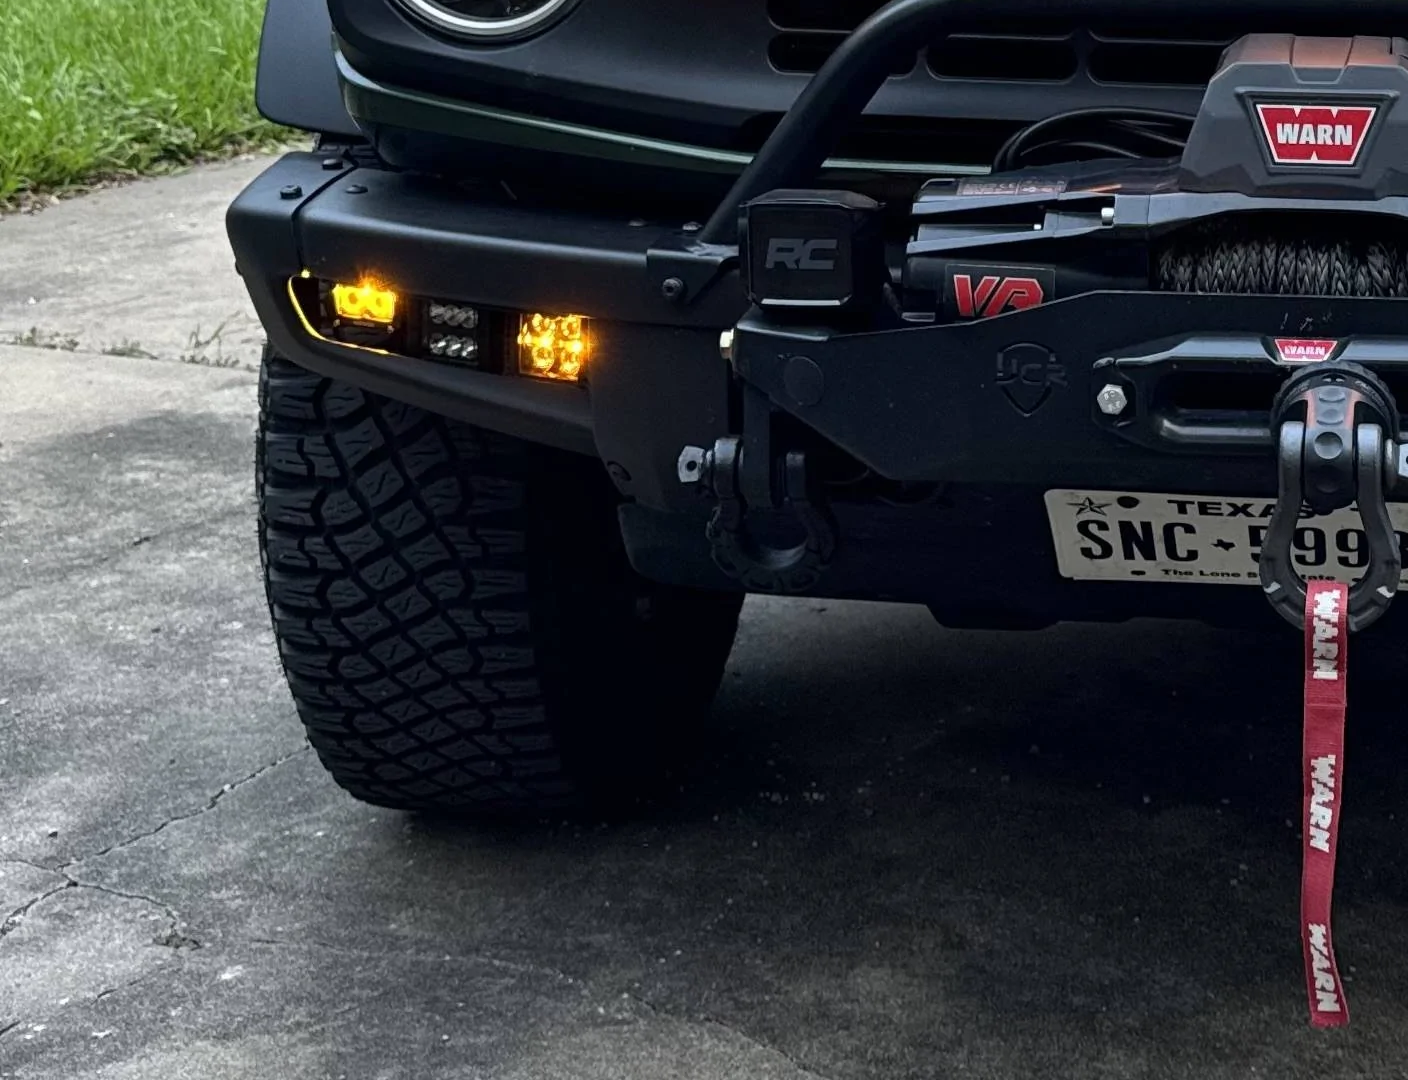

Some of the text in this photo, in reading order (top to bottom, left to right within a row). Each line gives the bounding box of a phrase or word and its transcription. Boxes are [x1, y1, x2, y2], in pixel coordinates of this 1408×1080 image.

[1276, 122, 1353, 146] WARN
[764, 237, 838, 271] RC
[953, 274, 1044, 317] VR
[1284, 344, 1326, 356] WARN
[1075, 519, 1199, 562] SNC
[1160, 568, 1194, 576] The
[1198, 569, 1242, 578] Lone
[1312, 589, 1341, 681] WARN
[1309, 754, 1336, 853] WARN
[1308, 922, 1341, 1013] WARN
